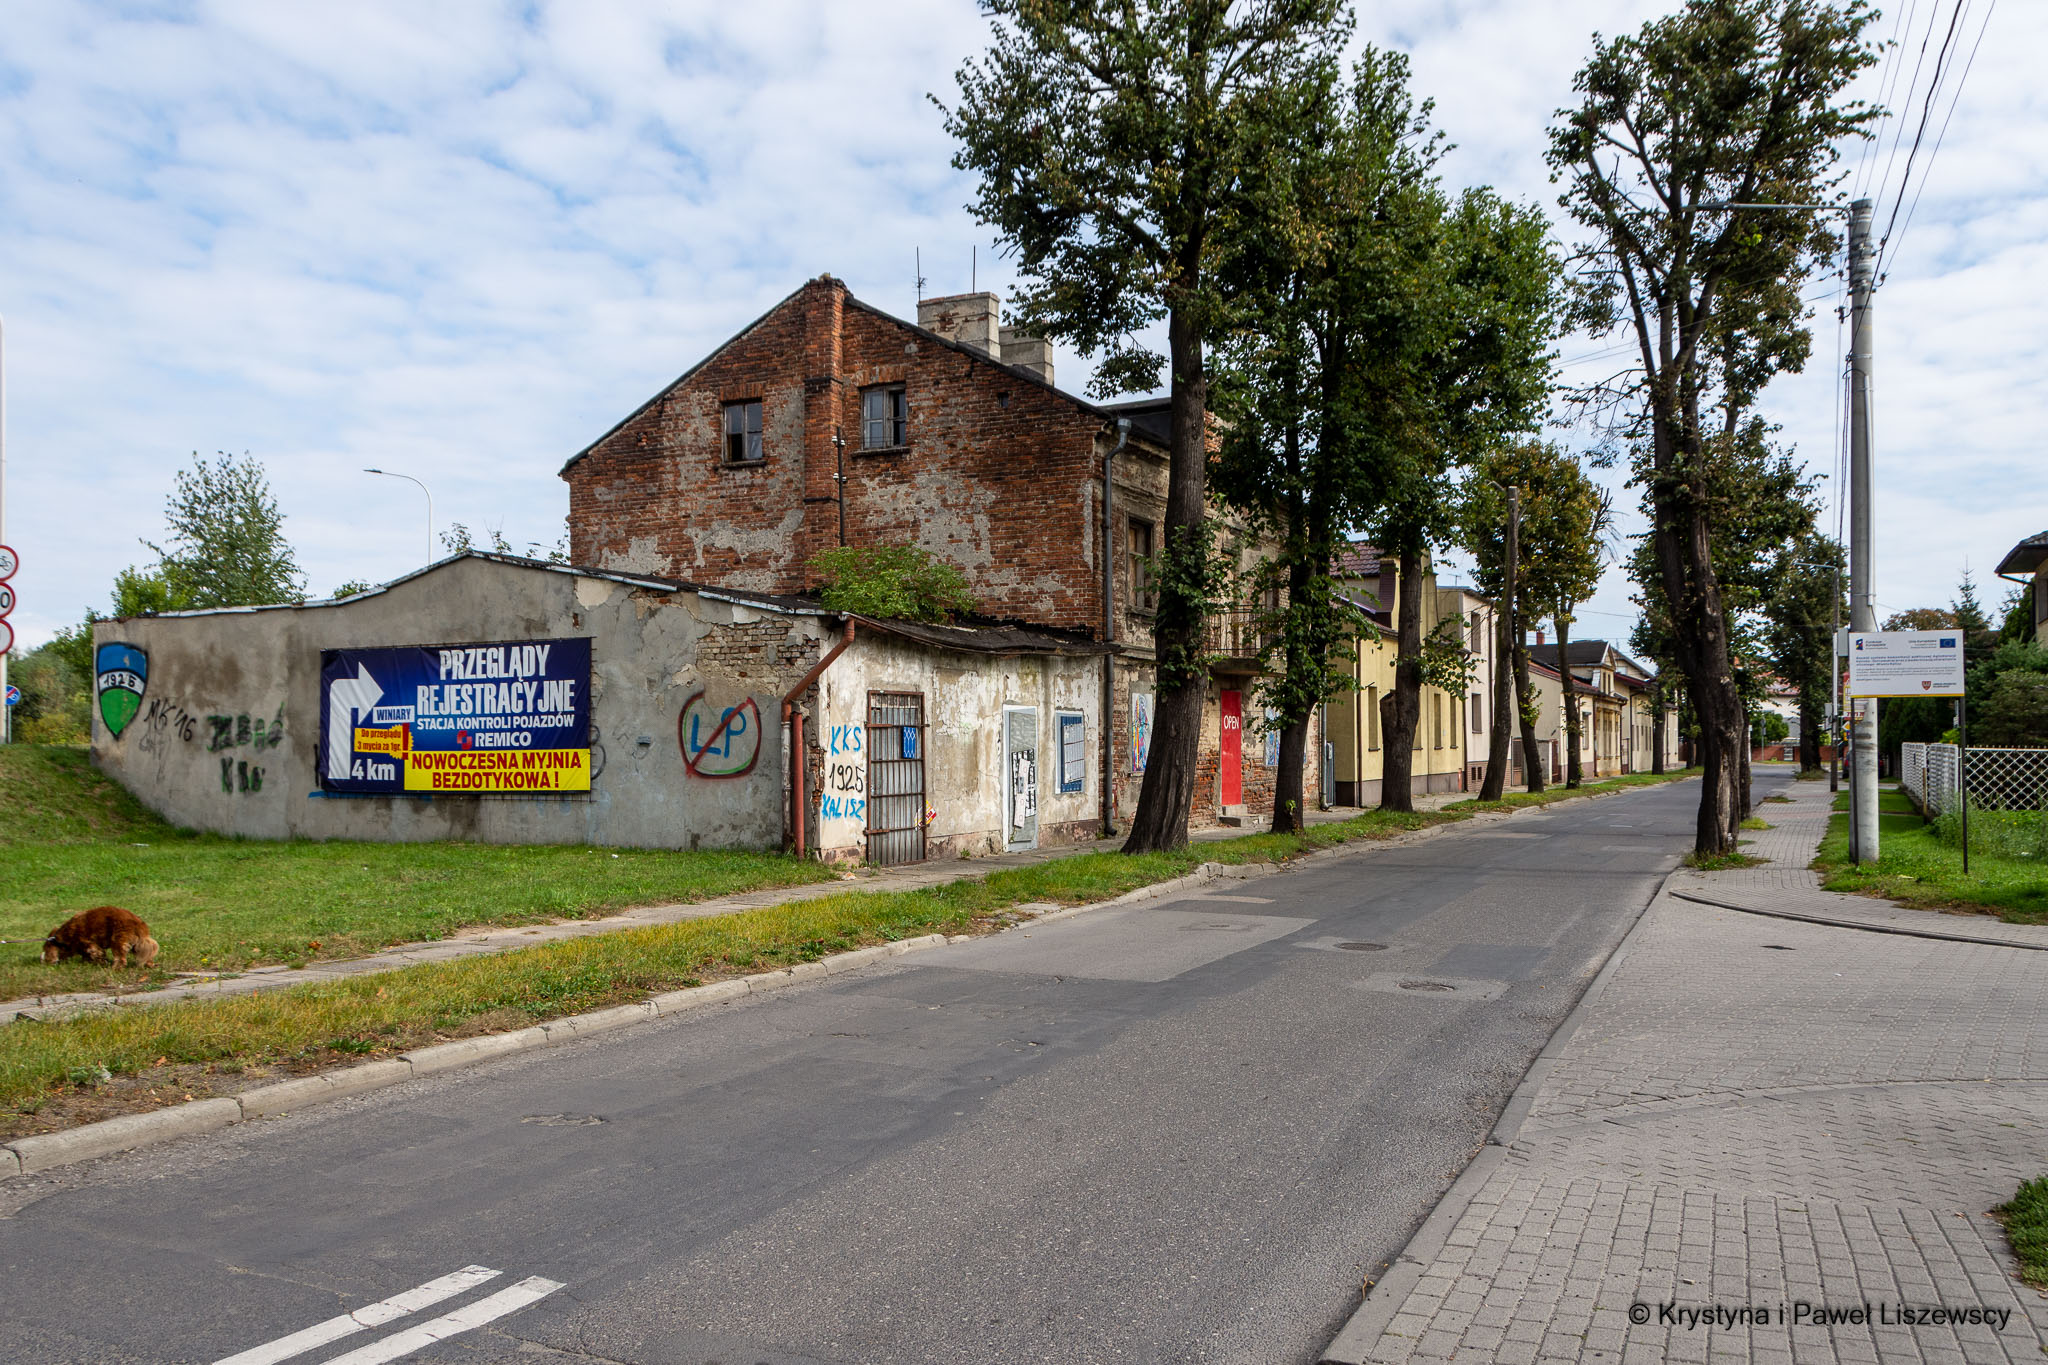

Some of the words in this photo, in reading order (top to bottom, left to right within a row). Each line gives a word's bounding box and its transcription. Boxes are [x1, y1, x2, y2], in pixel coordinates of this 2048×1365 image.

[439, 644, 550, 682] PRZEGLĄDY
[103, 673, 138, 688] 1925
[417, 679, 576, 716] REJESTRACYJNE
[376, 708, 411, 721] WINIARY
[417, 717, 455, 730] STACJA
[456, 715, 511, 730] KONTROLI
[512, 711, 575, 729] POJAZDÓW
[1223, 714, 1240, 730] OPEN
[474, 731, 532, 748] REMICO
[691, 706, 747, 759] LP
[830, 724, 862, 757] KKS
[357, 740, 362, 750] 3
[362, 741, 382, 751] mycia
[351, 759, 364, 780] 4
[366, 758, 396, 781] km
[412, 752, 519, 770] NOWOCZESNA
[522, 751, 582, 769] MYJNIA
[432, 771, 551, 789] BEZDOTYKOWA
[554, 771, 560, 788] !
[828, 762, 865, 794] 1925
[821, 793, 866, 822] KALISZ
